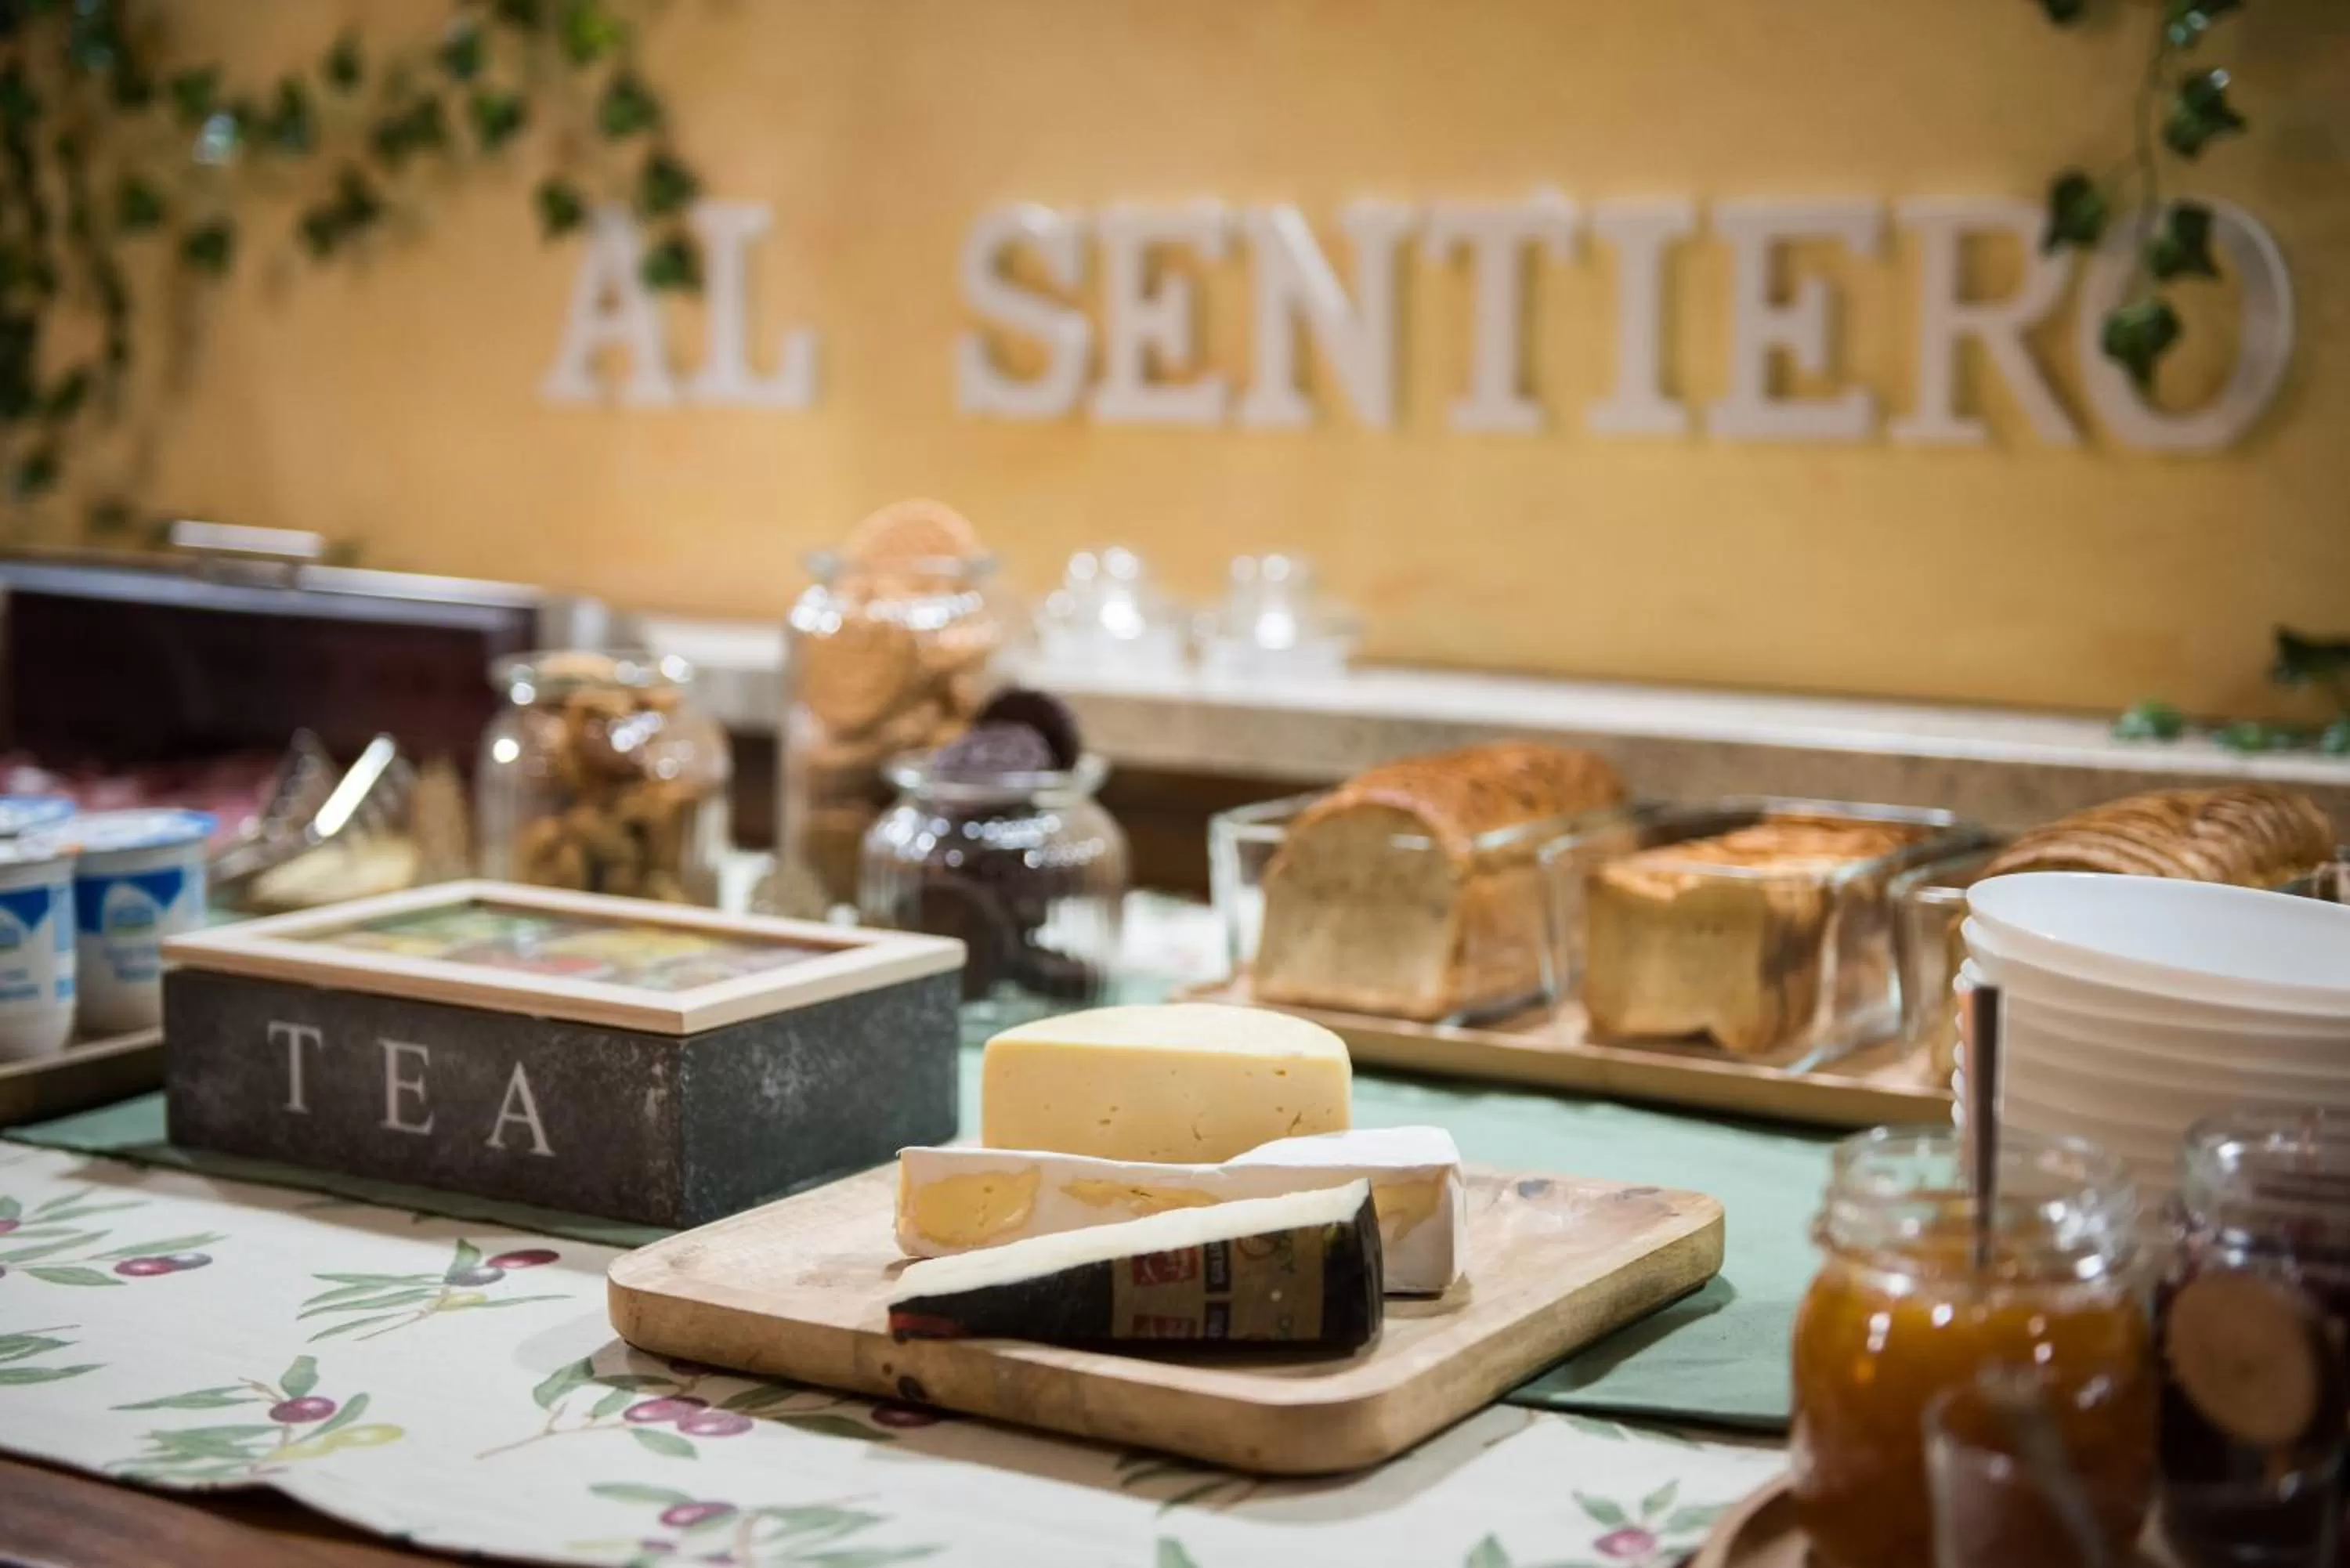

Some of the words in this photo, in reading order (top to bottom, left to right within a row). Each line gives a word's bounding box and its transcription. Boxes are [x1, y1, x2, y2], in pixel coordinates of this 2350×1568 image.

[539, 199, 817, 409] AL
[954, 191, 2295, 452] SENTIERO
[267, 1021, 555, 1158] TEA
